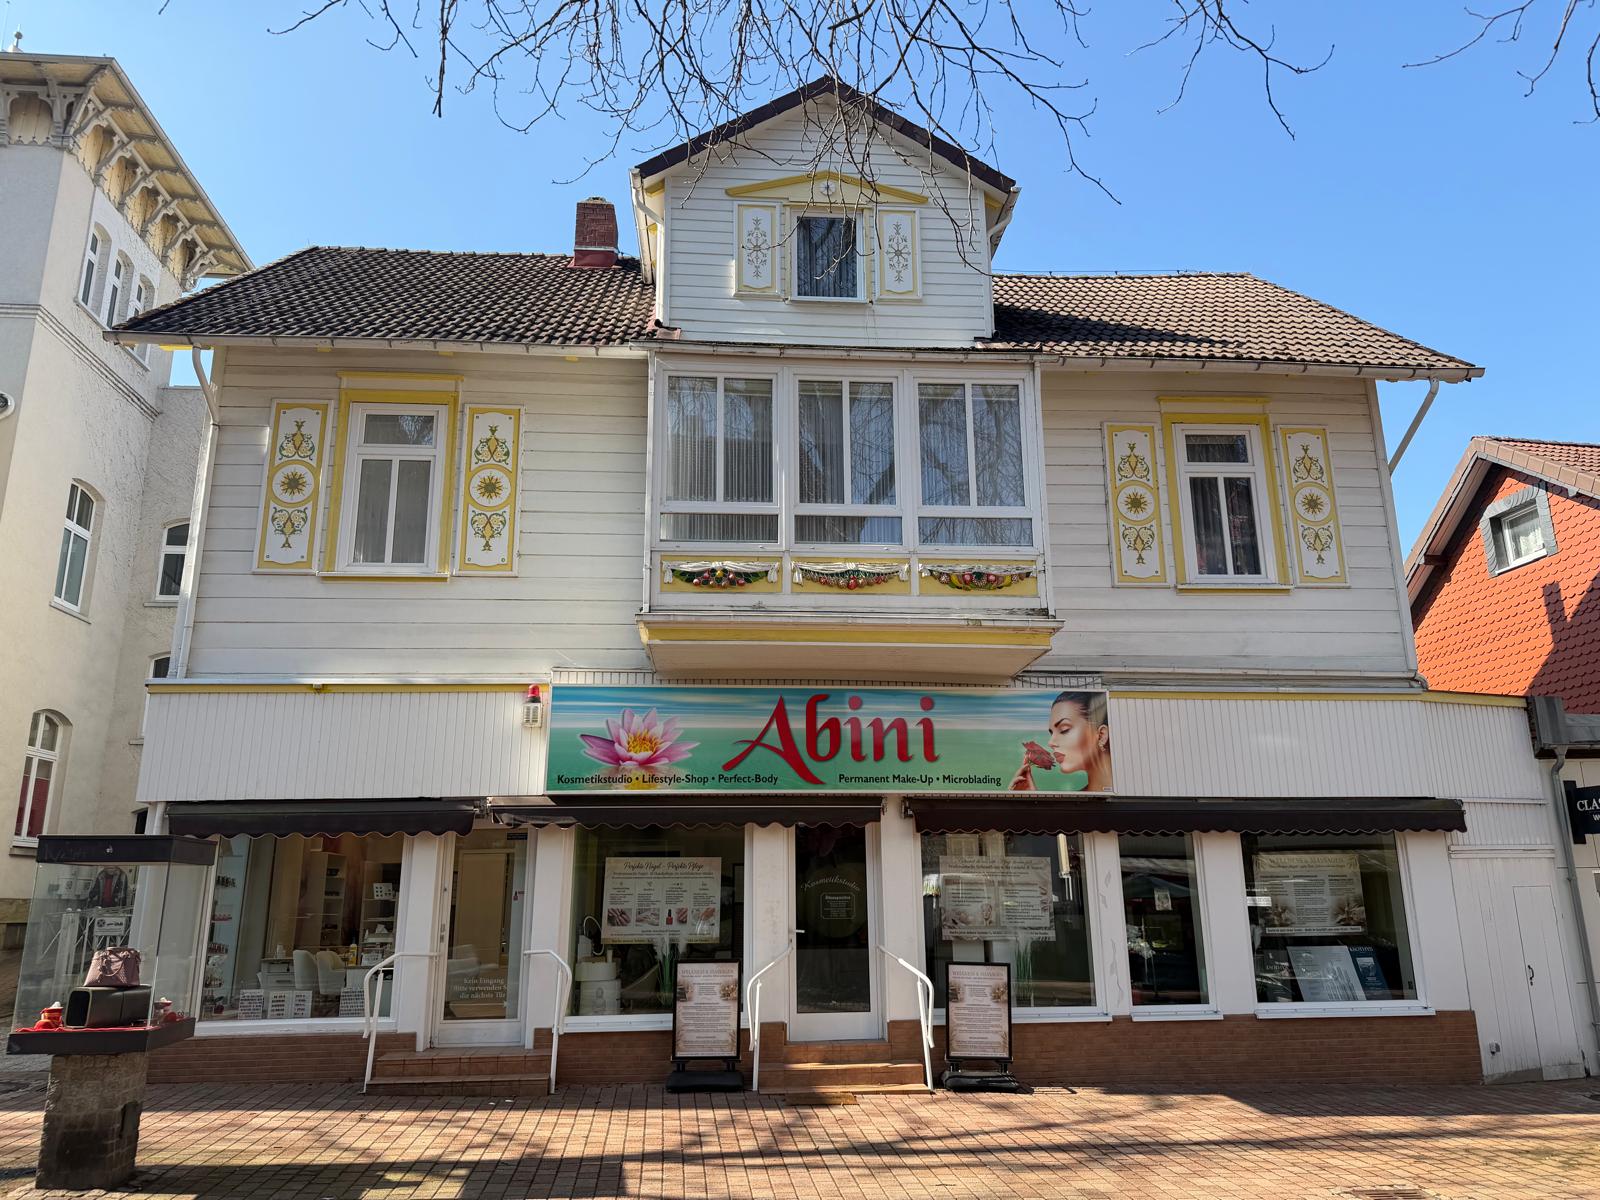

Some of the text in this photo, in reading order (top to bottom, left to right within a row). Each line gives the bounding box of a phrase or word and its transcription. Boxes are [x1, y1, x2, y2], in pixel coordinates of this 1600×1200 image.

[721, 693, 941, 785] Abini
[557, 774, 778, 786] Kosmetikstudio Lifestyle-Shop Perfect-Body
[838, 774, 1002, 786] Permanent Make-Up Microblading
[1576, 797, 1600, 811] CLA
[800, 875, 860, 891] Kosmetikstudio
[480, 977, 504, 985] Eingang
